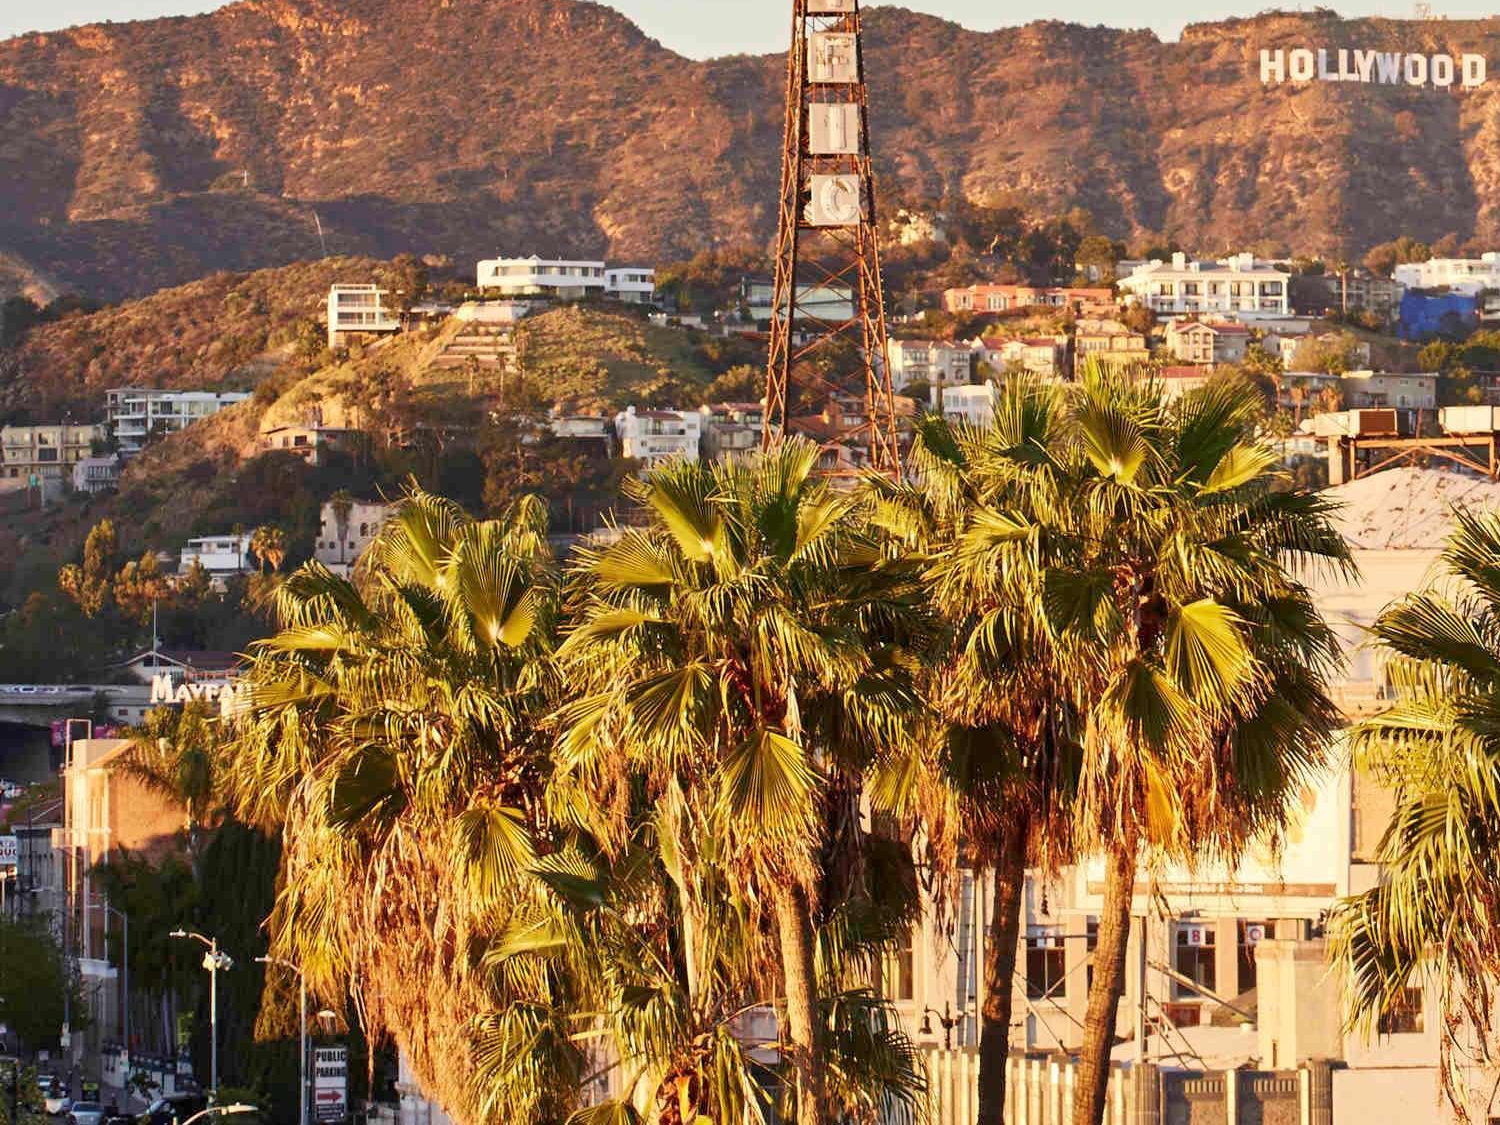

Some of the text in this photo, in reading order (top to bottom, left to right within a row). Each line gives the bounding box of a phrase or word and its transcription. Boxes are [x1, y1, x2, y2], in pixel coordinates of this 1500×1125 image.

[1258, 48, 1488, 89] HOLLYWOOD
[150, 673, 254, 704] MAYFAI
[316, 1050, 347, 1063] PUBLIC
[316, 1066, 347, 1079] PARKING
